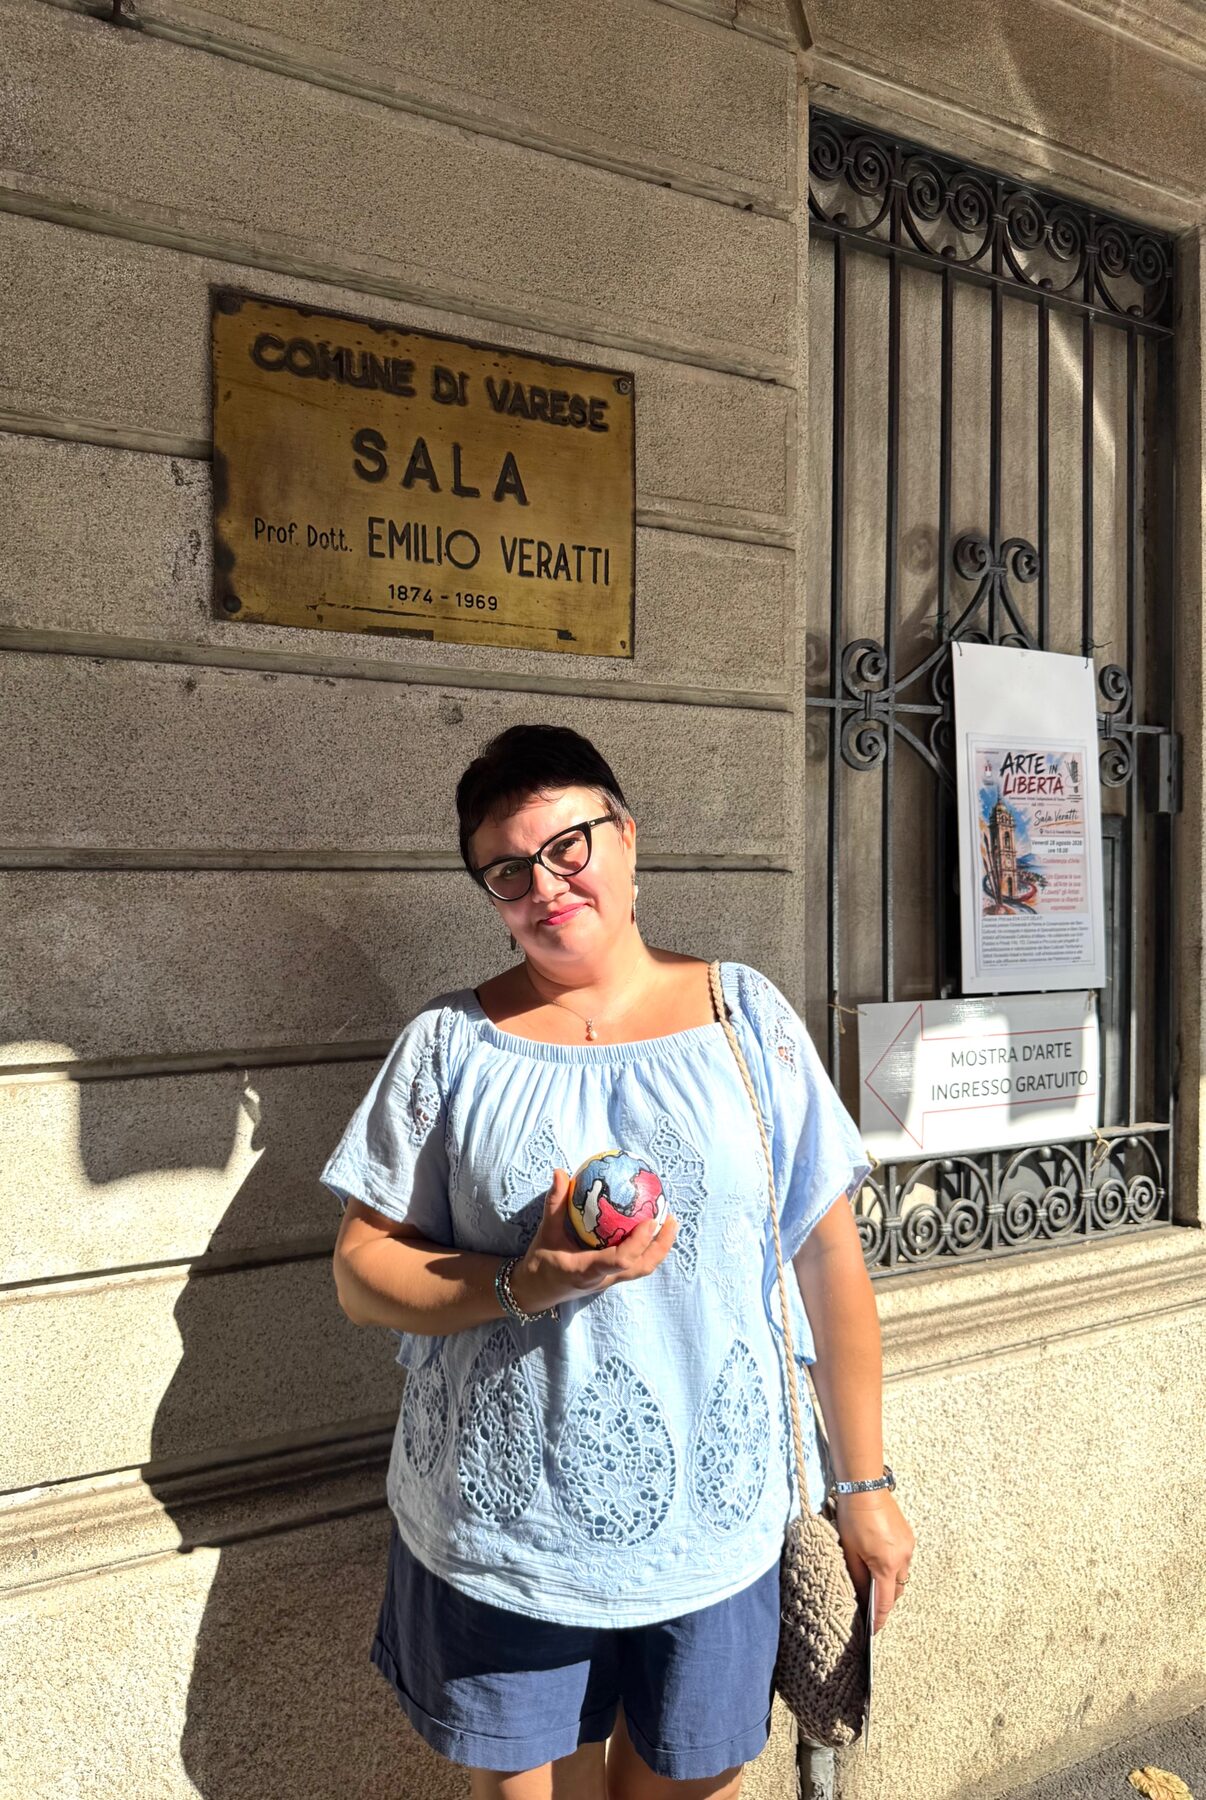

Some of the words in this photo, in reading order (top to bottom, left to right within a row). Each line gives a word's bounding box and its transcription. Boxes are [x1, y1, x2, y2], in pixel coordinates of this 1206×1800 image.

[251, 332, 417, 398] COMUNE
[431, 365, 470, 407] DI
[484, 375, 610, 432] VARESE
[352, 428, 530, 506] SALA
[307, 524, 353, 552] Dott.
[368, 516, 481, 570] EMILIO
[500, 535, 610, 586] VERATTI
[388, 584, 433, 604] 1874
[455, 592, 498, 611] 1969
[1000, 752, 1046, 776] ARTE
[1049, 764, 1058, 774] IN
[1003, 773, 1064, 797] LIBERTÀ
[1033, 810, 1053, 827] Sala
[1054, 809, 1079, 822] Veratti
[951, 1047, 1018, 1068] MOSTRA
[1022, 1041, 1072, 1062] D'ARTE
[931, 1078, 1012, 1101] INGRESSO
[1015, 1070, 1088, 1093] GRATUITO
